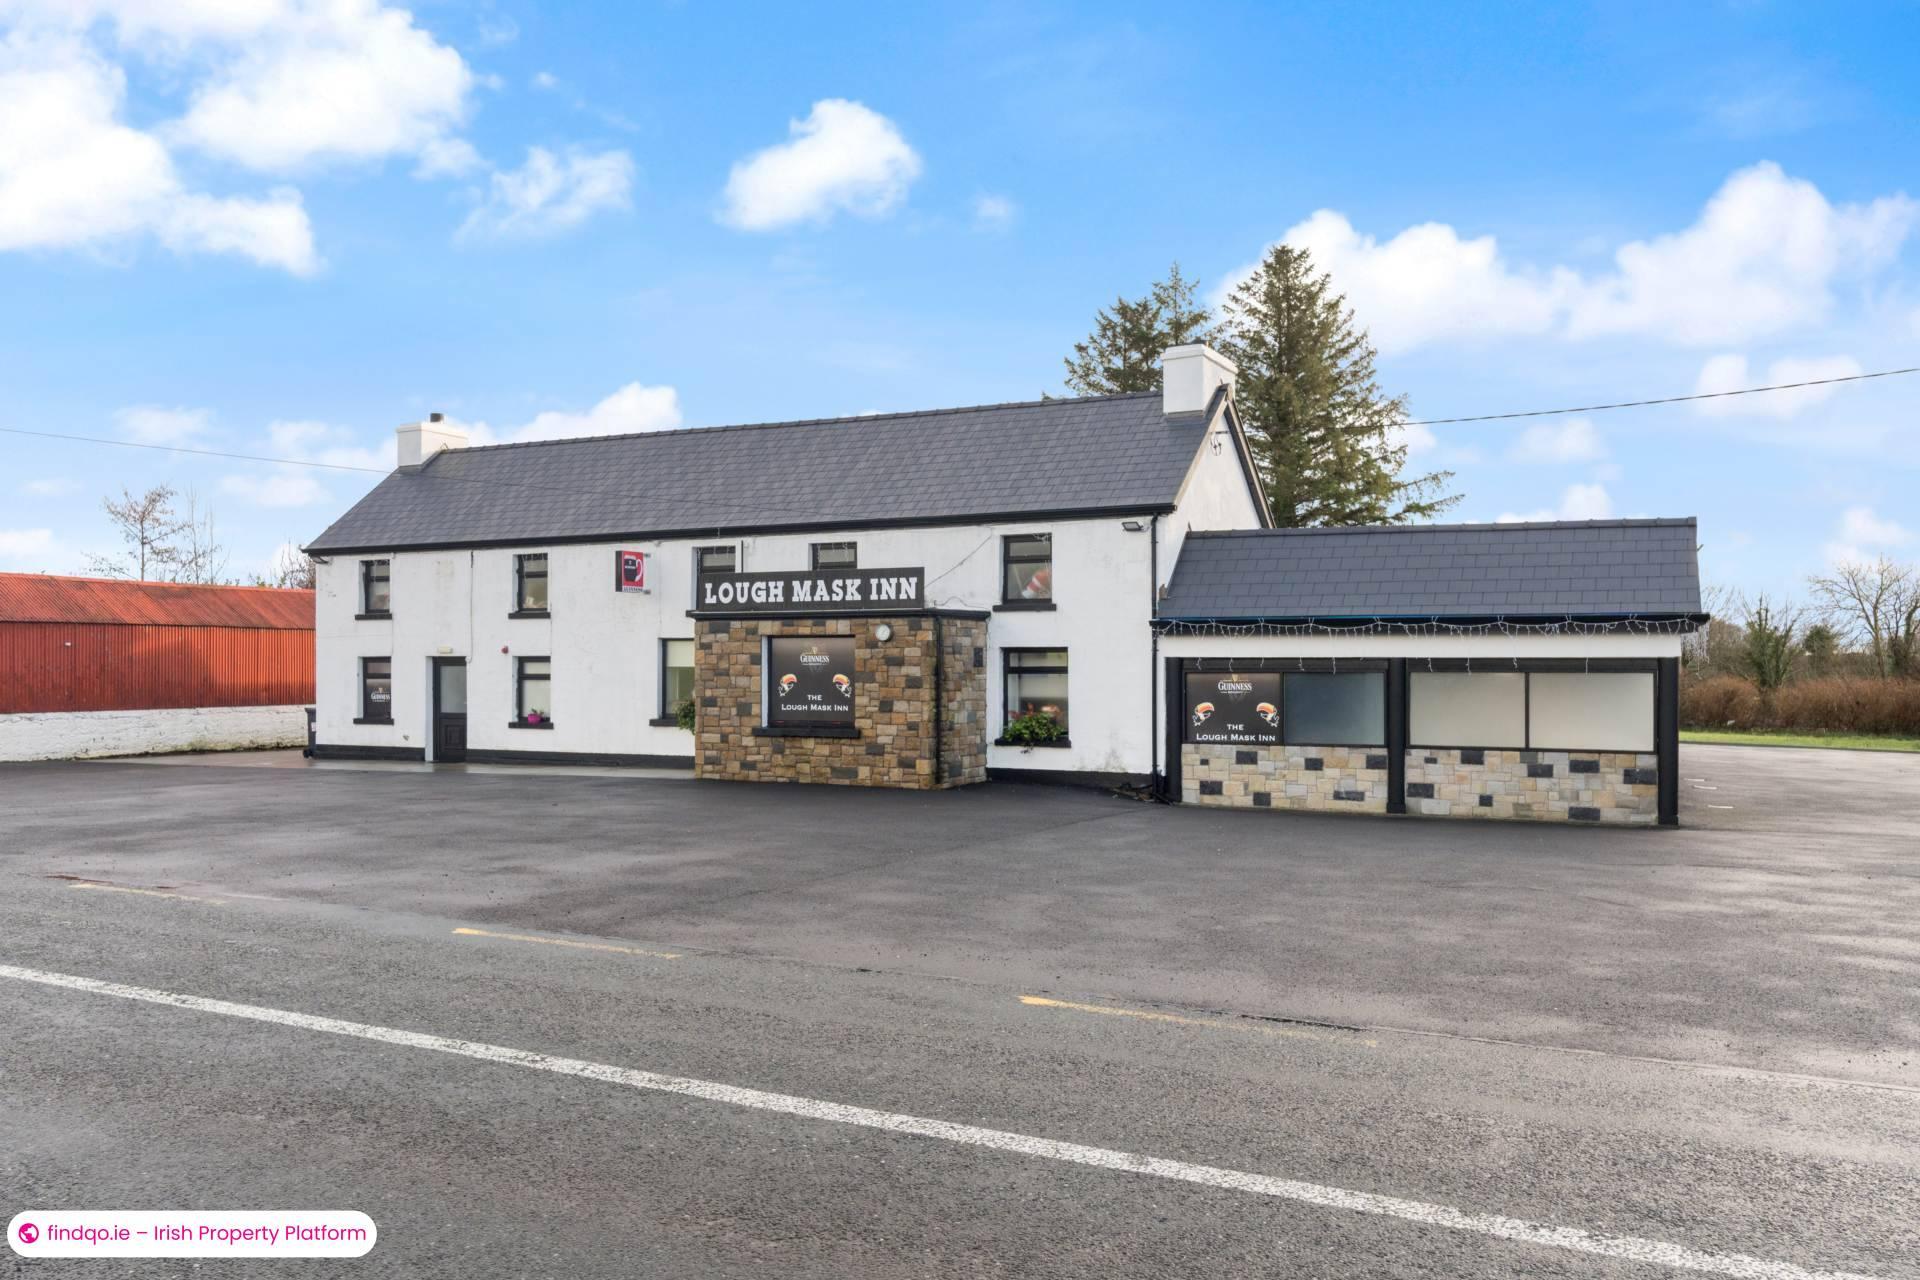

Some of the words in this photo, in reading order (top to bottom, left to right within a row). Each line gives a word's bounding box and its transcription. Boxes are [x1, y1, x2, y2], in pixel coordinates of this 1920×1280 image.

[704, 581, 784, 604] LOUGH
[792, 579, 861, 602] MASK
[870, 577, 918, 600] INN
[800, 655, 830, 663] GUINNESS
[1218, 681, 1252, 691] GUINNESS
[781, 703, 808, 711] LOUGH
[810, 703, 832, 712] MASK
[834, 704, 849, 712] INN
[1227, 723, 1244, 731] THE
[1196, 732, 1227, 741] LOUGH
[1230, 733, 1256, 742] MASK
[1259, 734, 1276, 742] INN
